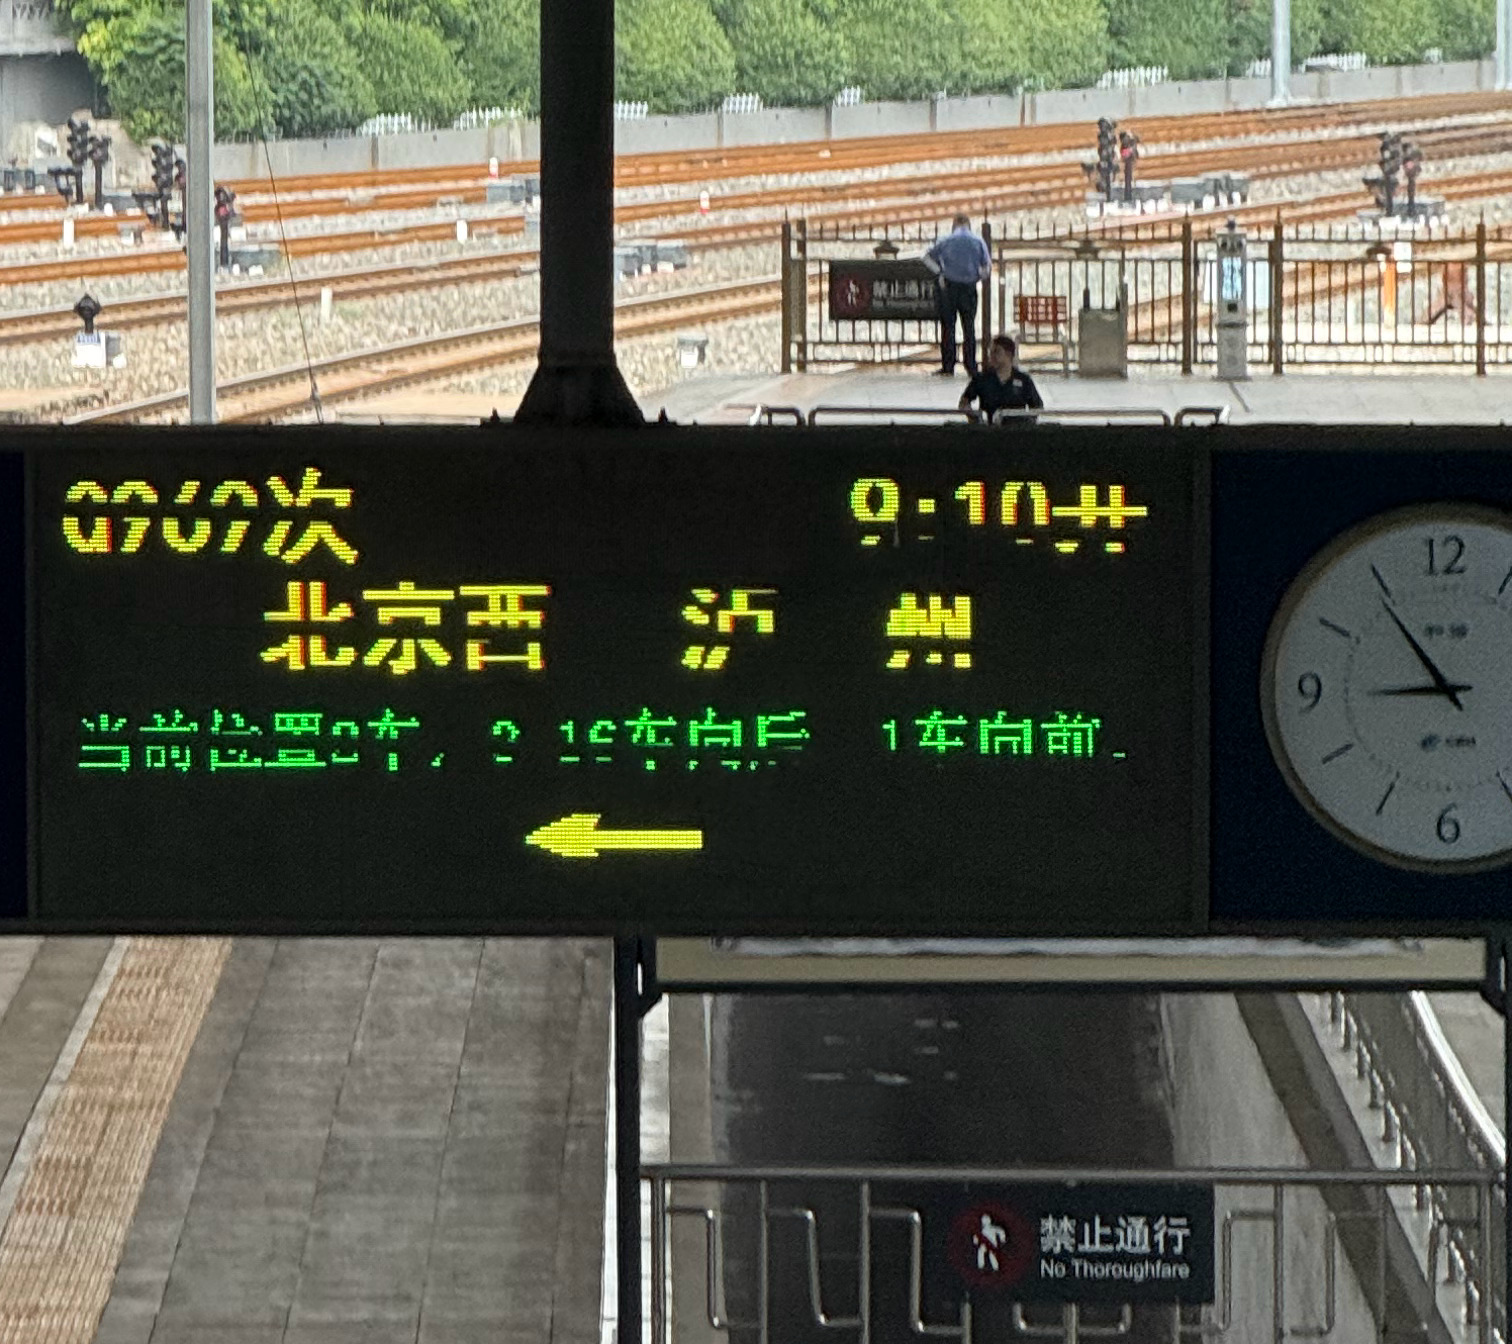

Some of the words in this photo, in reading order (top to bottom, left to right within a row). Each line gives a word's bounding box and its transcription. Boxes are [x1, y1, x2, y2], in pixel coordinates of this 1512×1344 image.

[1424, 534, 1467, 577] 12
[260, 580, 551, 674] 北京西
[1297, 670, 1323, 713] 9
[1435, 802, 1461, 844] 6
[1039, 1213, 1192, 1255] 禁止通行
[1039, 1258, 1067, 1280] No
[1071, 1257, 1191, 1283] Thoroughfare
